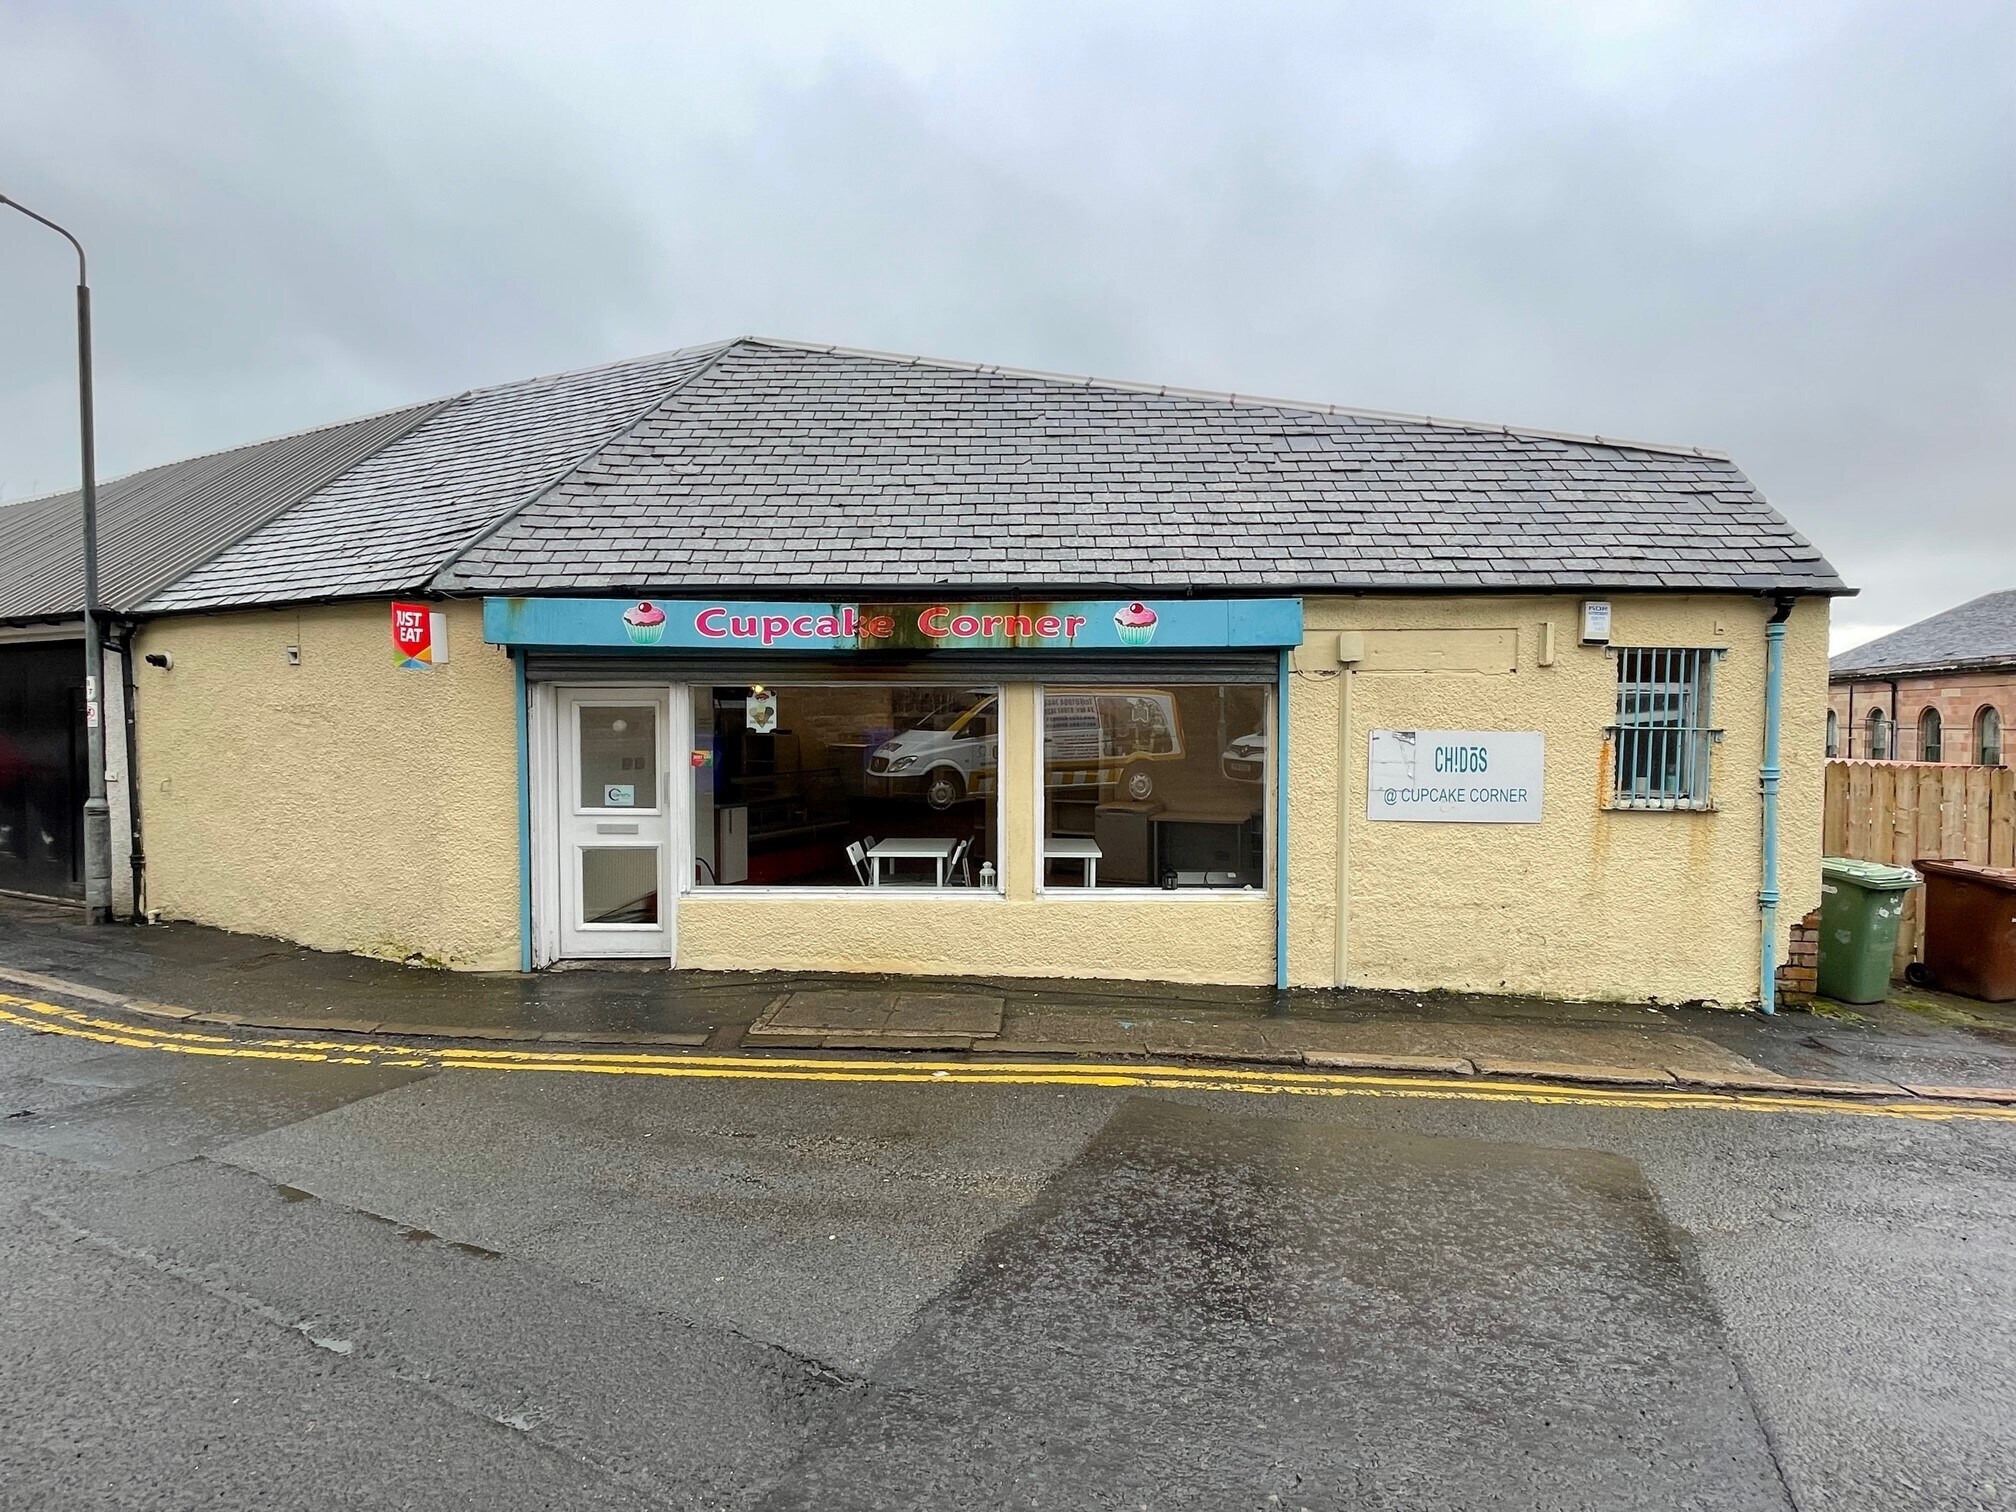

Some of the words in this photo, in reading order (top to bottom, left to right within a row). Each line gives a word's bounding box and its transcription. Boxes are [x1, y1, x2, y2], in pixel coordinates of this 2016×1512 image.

[396, 610, 423, 627] JUST
[695, 607, 895, 646] Cupcake
[917, 606, 1087, 638] Corner
[400, 626, 424, 643] EAT
[1383, 787, 1398, 806] @
[1401, 787, 1466, 803] CUPCAKE
[1469, 788, 1528, 803] CORNER
